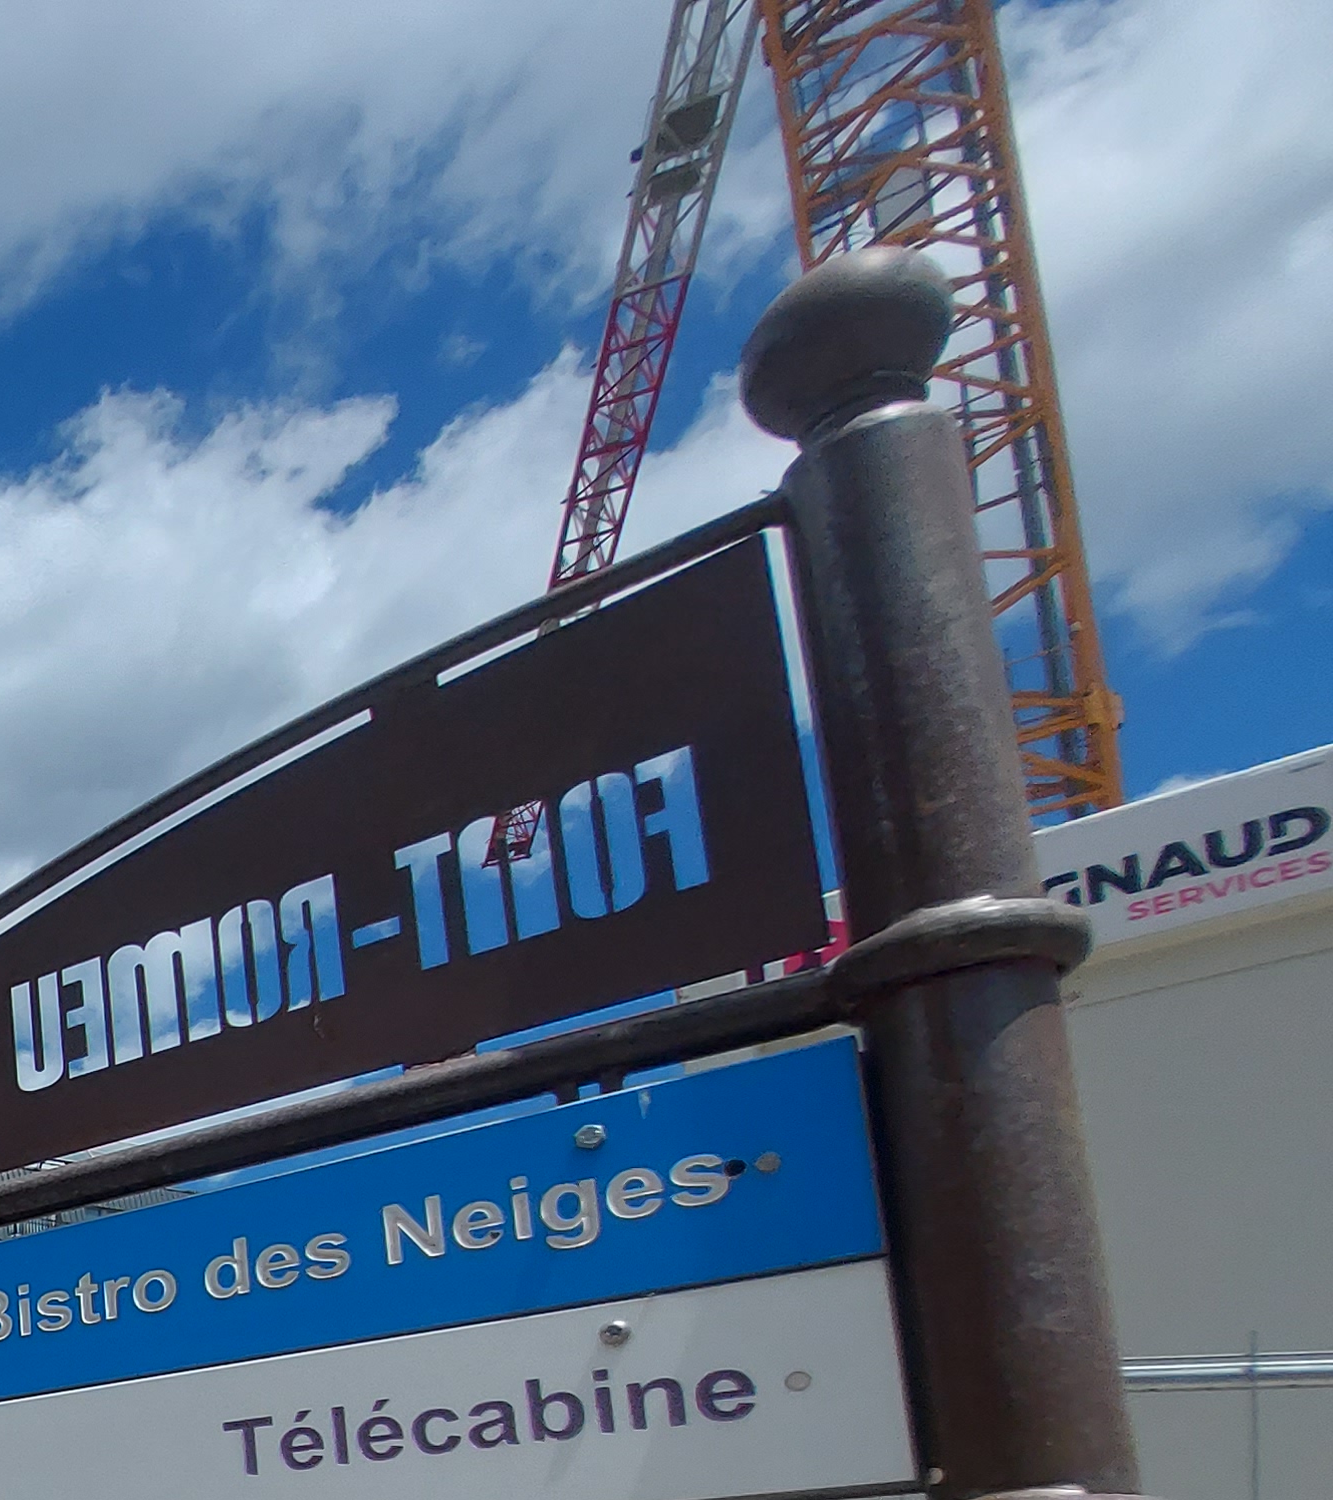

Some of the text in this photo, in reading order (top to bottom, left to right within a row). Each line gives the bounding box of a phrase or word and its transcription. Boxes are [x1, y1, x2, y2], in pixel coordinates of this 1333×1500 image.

[1127, 851, 1332, 921] SERVICES
[204, 1232, 352, 1300] des
[381, 1153, 731, 1265] Neiges
[222, 1368, 756, 1476] Télécabine
